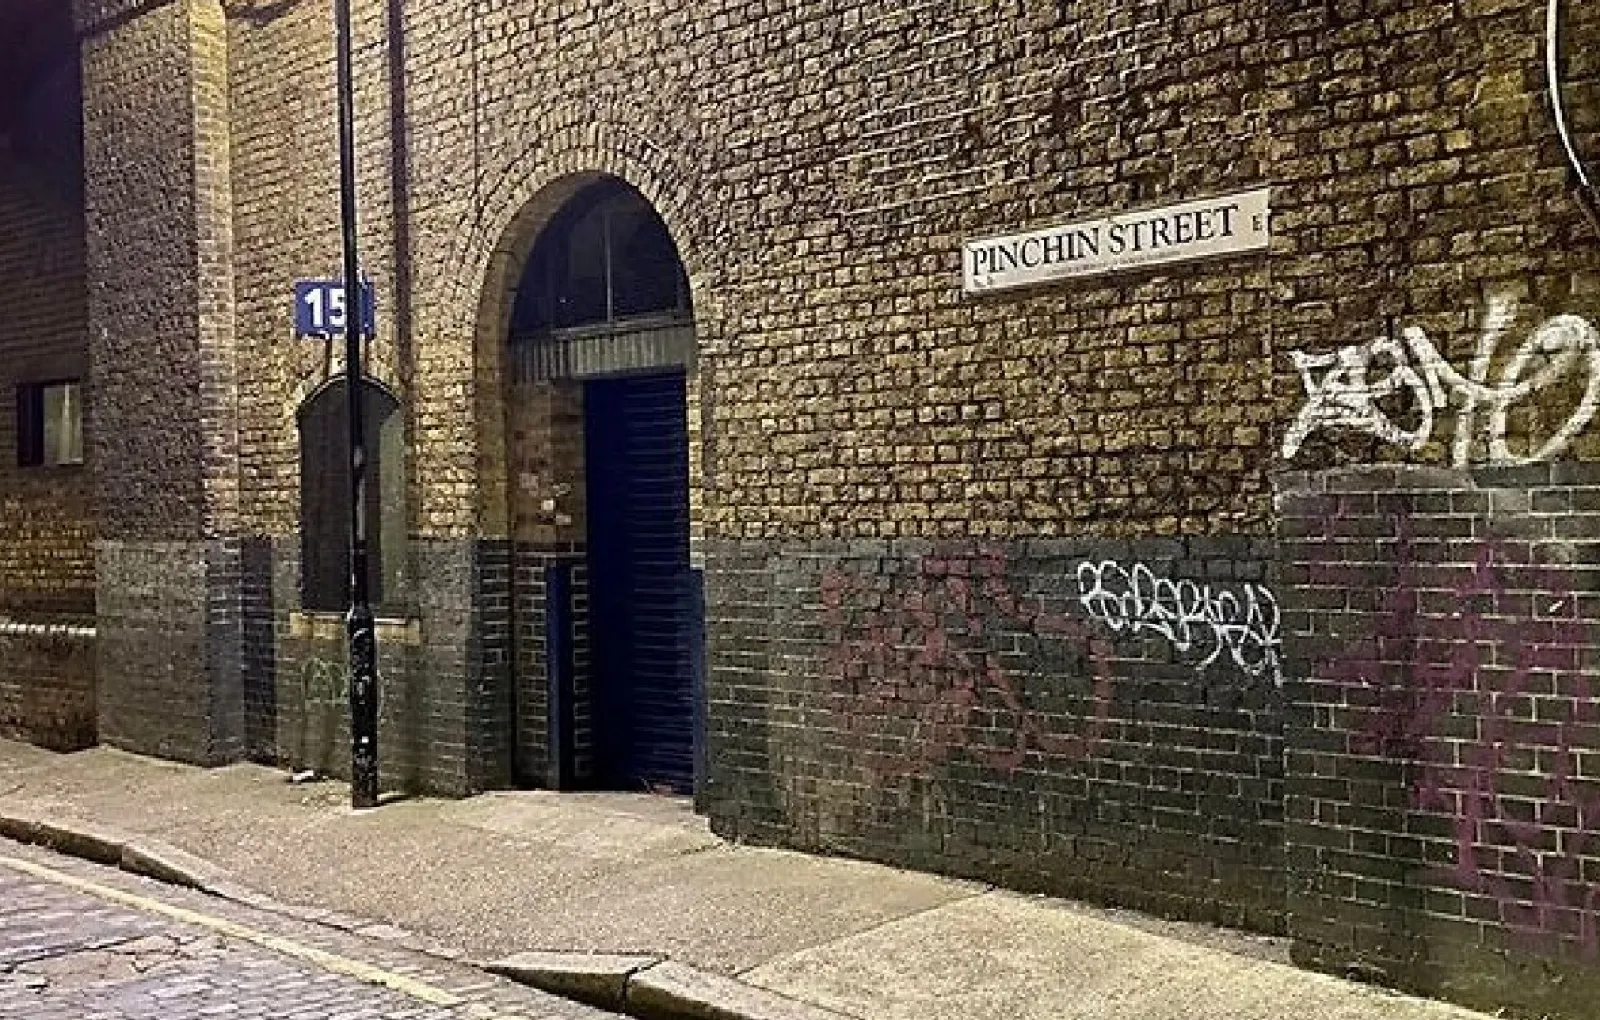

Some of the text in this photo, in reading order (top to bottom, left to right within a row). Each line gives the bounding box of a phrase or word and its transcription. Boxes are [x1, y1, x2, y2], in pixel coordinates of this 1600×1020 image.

[969, 227, 1099, 275] PINCHIN
[1110, 203, 1239, 255] STREET
[304, 288, 346, 327] 15
